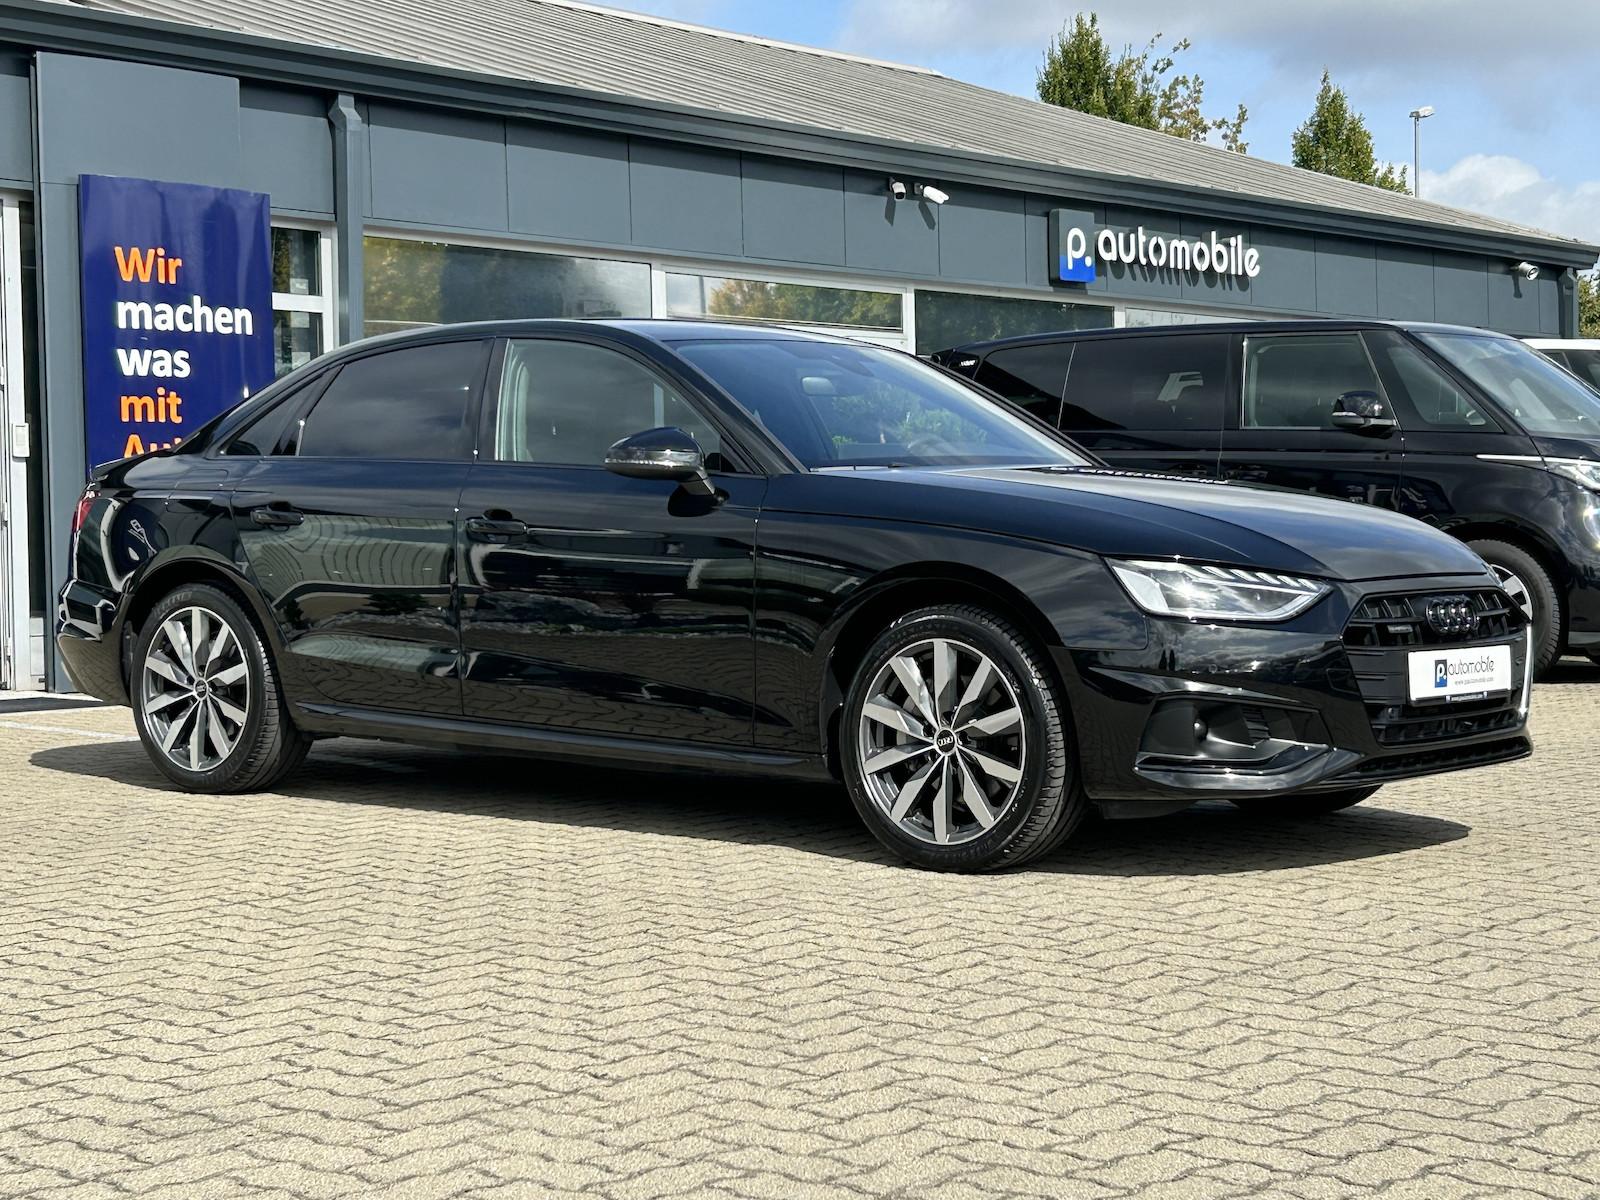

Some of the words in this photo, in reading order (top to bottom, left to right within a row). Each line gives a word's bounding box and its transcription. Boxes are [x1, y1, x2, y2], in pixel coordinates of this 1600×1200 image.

[115, 246, 182, 284] Wir
[1098, 226, 1260, 277] automobile
[117, 295, 253, 335] machen
[117, 348, 191, 378] was
[121, 387, 182, 423] mit
[1448, 656, 1495, 676] automobile
